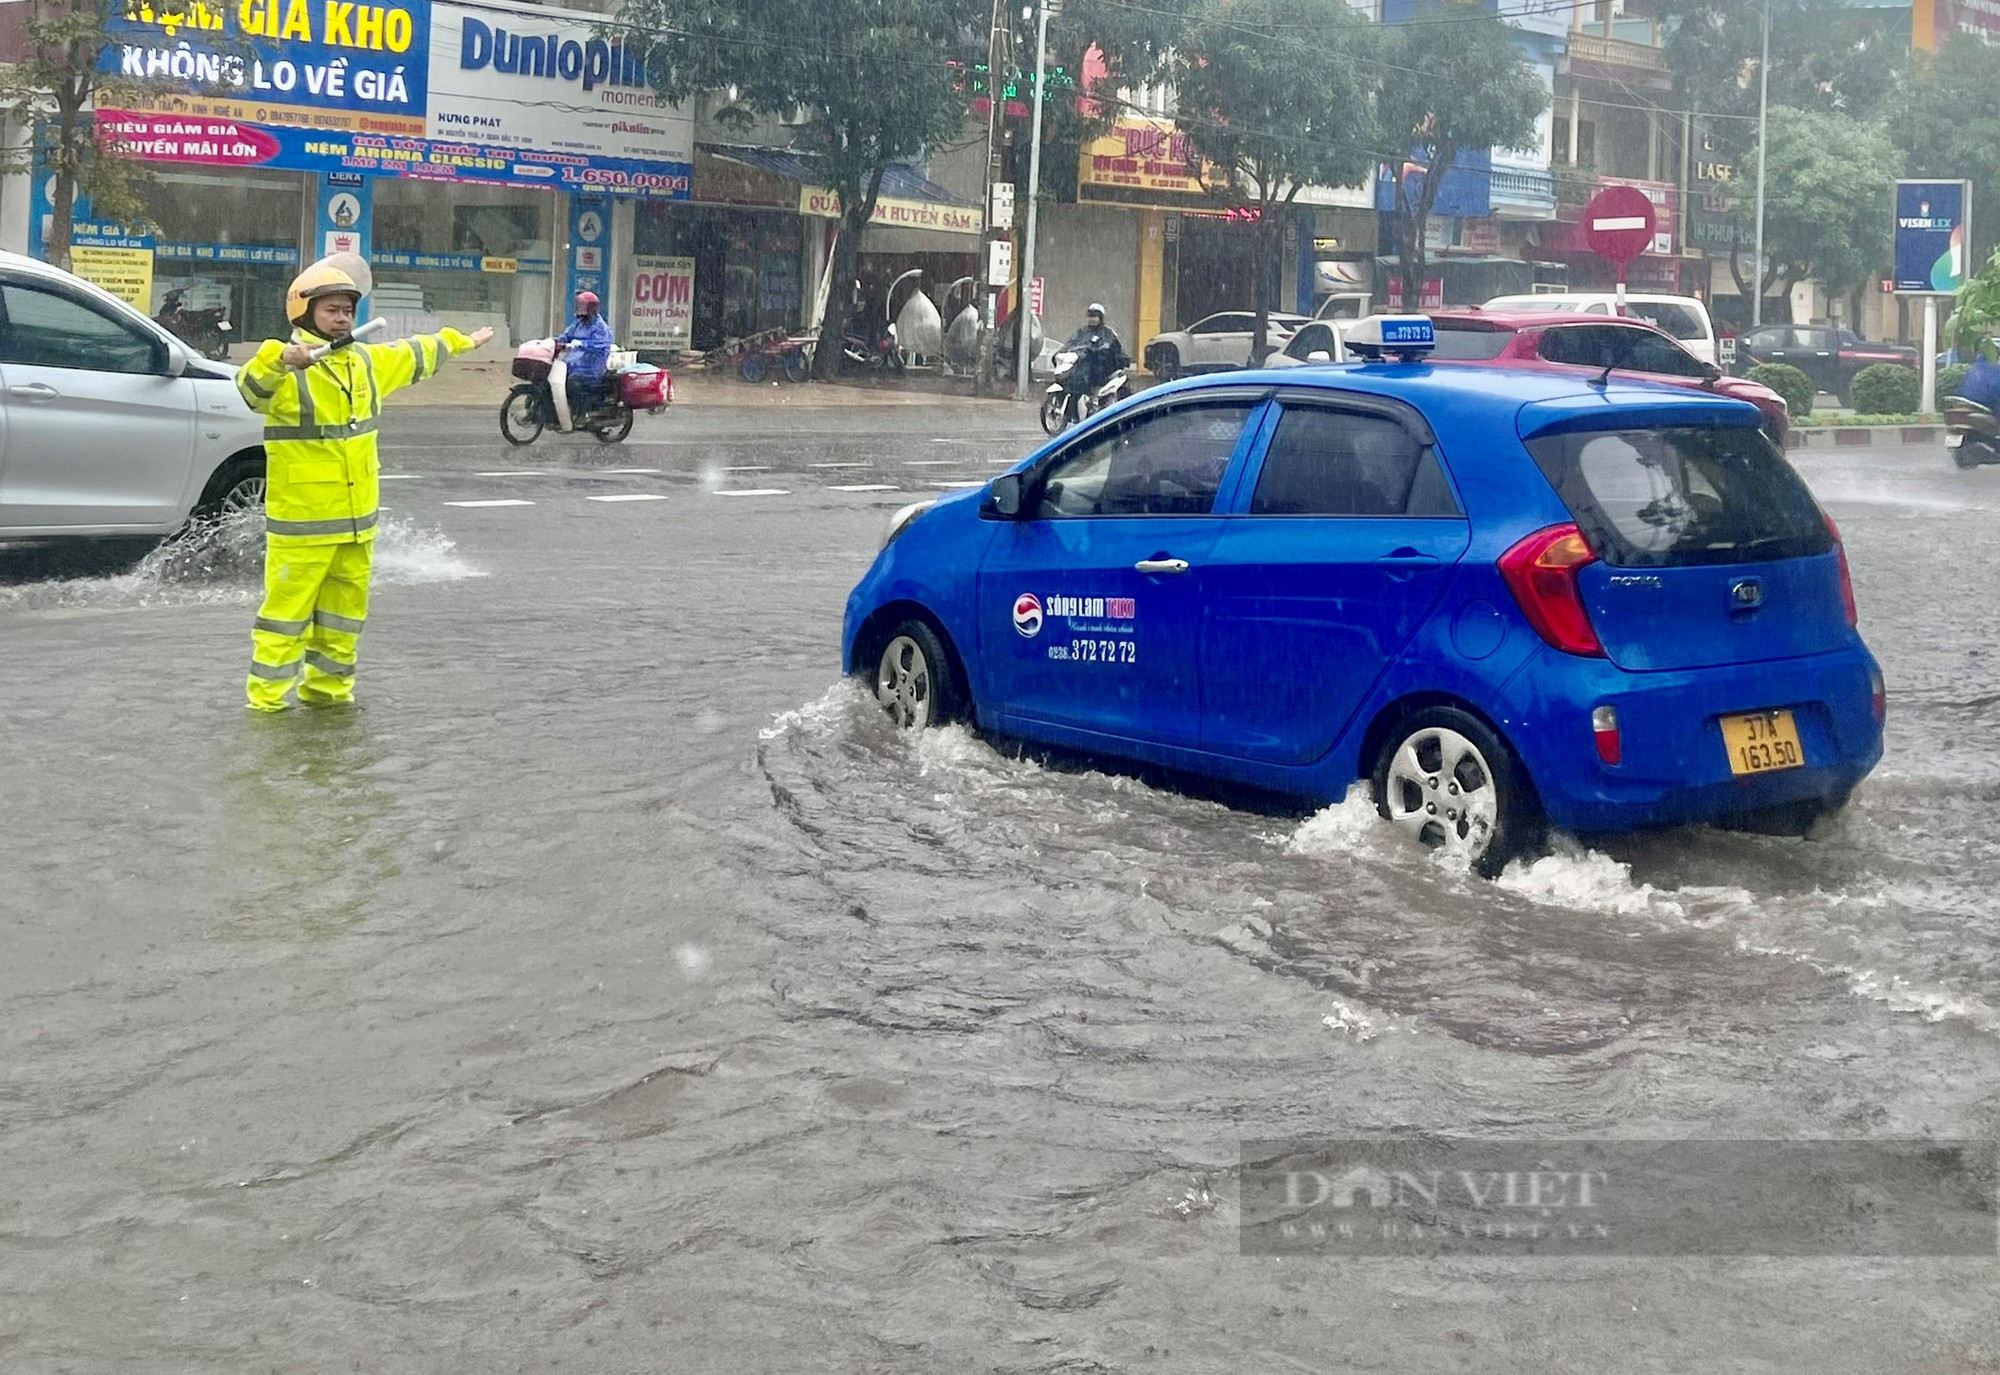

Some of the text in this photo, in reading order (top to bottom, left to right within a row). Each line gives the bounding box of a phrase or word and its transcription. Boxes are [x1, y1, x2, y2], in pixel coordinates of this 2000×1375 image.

[323, 1, 412, 52] KHO
[122, 41, 408, 103] KHÔNG LO VỀ GIÁ
[353, 146, 424, 162] AROMA
[429, 153, 507, 170] CLASSIC
[1899, 218, 1952, 229] VISENLEX
[635, 272, 690, 305] CƠM
[1744, 716, 1778, 741] 37A
[1740, 740, 1797, 771] 163.50
